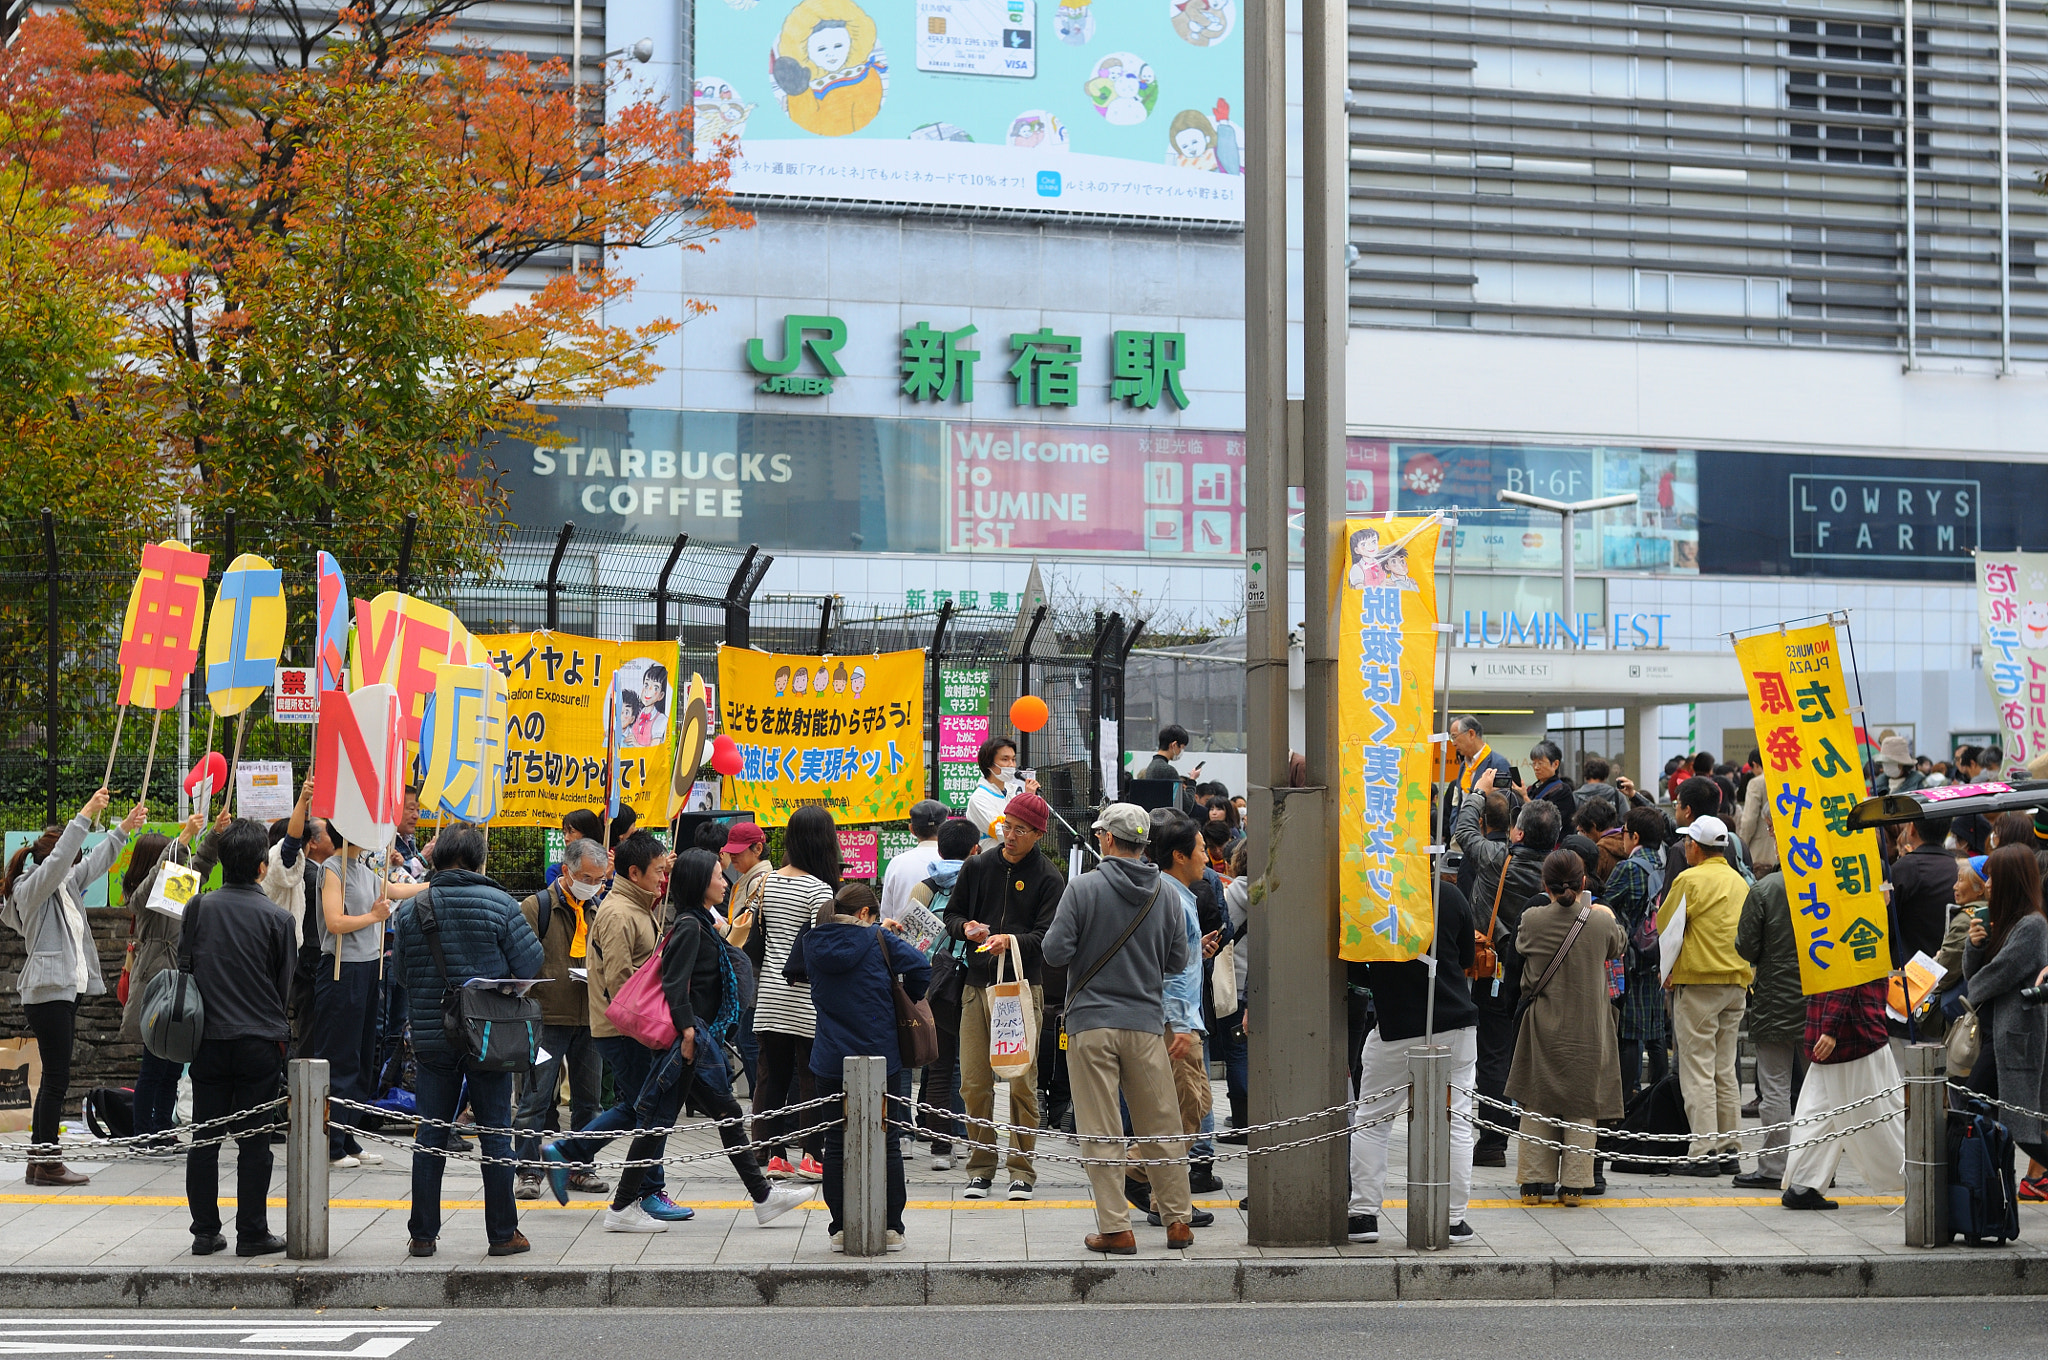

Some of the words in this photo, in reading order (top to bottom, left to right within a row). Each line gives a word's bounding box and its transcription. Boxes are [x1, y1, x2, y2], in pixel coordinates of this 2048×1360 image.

[1005, 60, 1028, 70] VISA
[746, 314, 848, 377] JR
[902, 321, 1191, 410] 新宿駅
[761, 376, 834, 396] JR東日本
[956, 431, 1110, 464] Welcome
[1138, 438, 1203, 455] 欢迎光临
[1226, 440, 1246, 457] 歡
[532, 445, 793, 483] STARBUCKS
[956, 461, 992, 487] to
[581, 485, 744, 519] COFFEE
[958, 490, 1087, 522] LUMINE
[1800, 486, 1971, 517] LOWRYS
[1440, 506, 1483, 518] EUND
[958, 521, 1015, 548] EST
[1483, 535, 1504, 545] VISA
[1816, 524, 1954, 552] FARM
[1248, 591, 1265, 600] 0112
[117, 543, 210, 709] 再
[1464, 610, 1598, 647] LUMINE
[1614, 613, 1671, 648] EST
[943, 671, 989, 685] 子どもたちを
[1487, 664, 1529, 676] LUMINE
[1531, 665, 1549, 676] EST
[505, 688, 533, 701] iation
[536, 688, 590, 708] Exposure!!!
[945, 685, 986, 698] 放射能から
[951, 699, 979, 712] 守ろう!
[508, 711, 545, 742] への
[727, 700, 912, 737] 子どもを放射能から守ろう!
[943, 718, 987, 731] 子どもたちの
[419, 664, 508, 818] 原
[956, 732, 976, 743] ために
[942, 764, 983, 777] 子どもたち
[943, 778, 979, 791] 放射能か
[518, 789, 536, 799] from
[548, 831, 566, 847] 子ど
[837, 833, 876, 846] もたちの
[881, 833, 919, 846] 子どもた
